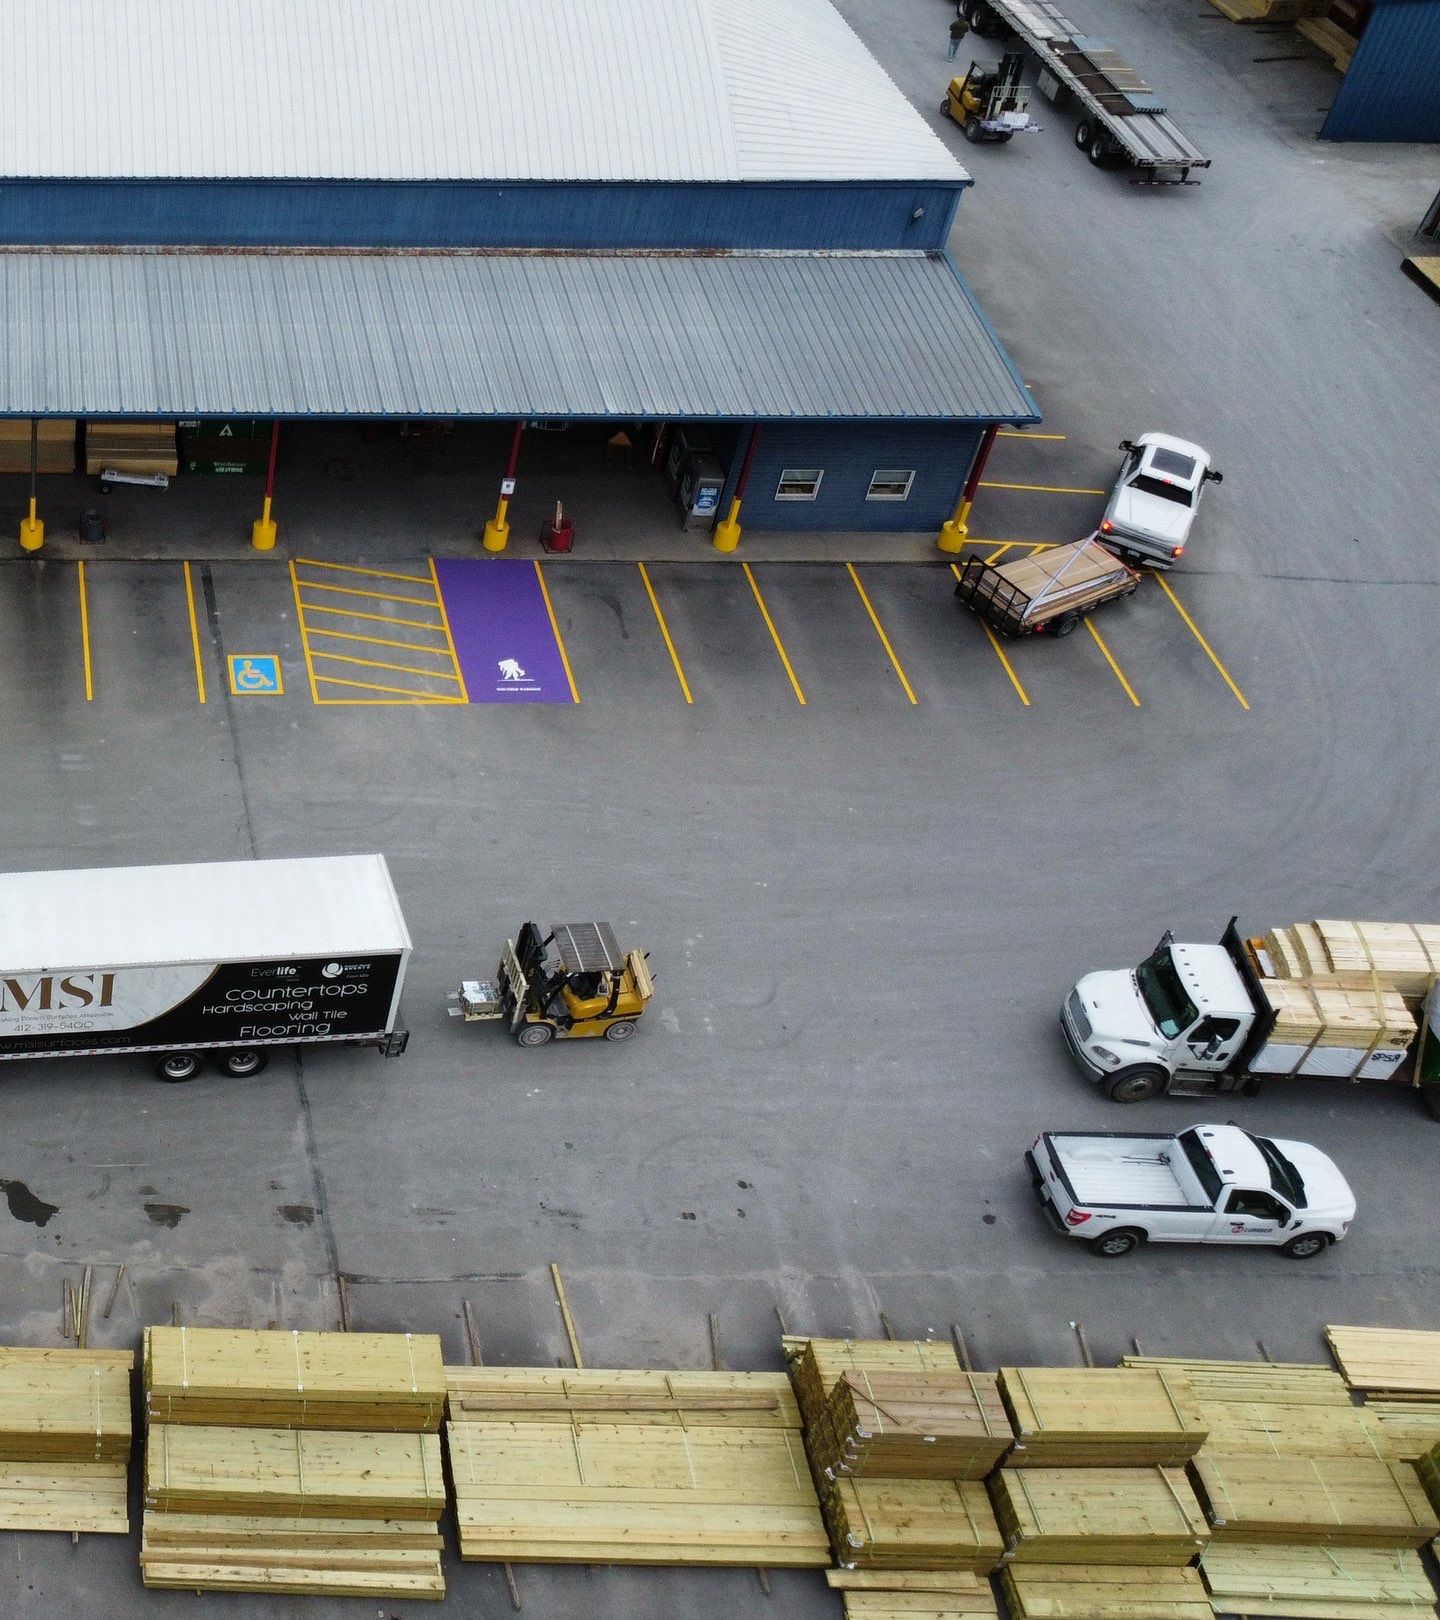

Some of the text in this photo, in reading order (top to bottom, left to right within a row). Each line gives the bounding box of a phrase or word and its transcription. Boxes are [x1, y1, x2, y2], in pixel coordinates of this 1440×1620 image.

[225, 983, 368, 1001] Countertops
[202, 1001, 313, 1015] Hardscaping
[288, 1010, 348, 1021] Wall Tile
[239, 1022, 331, 1037] Flooring
